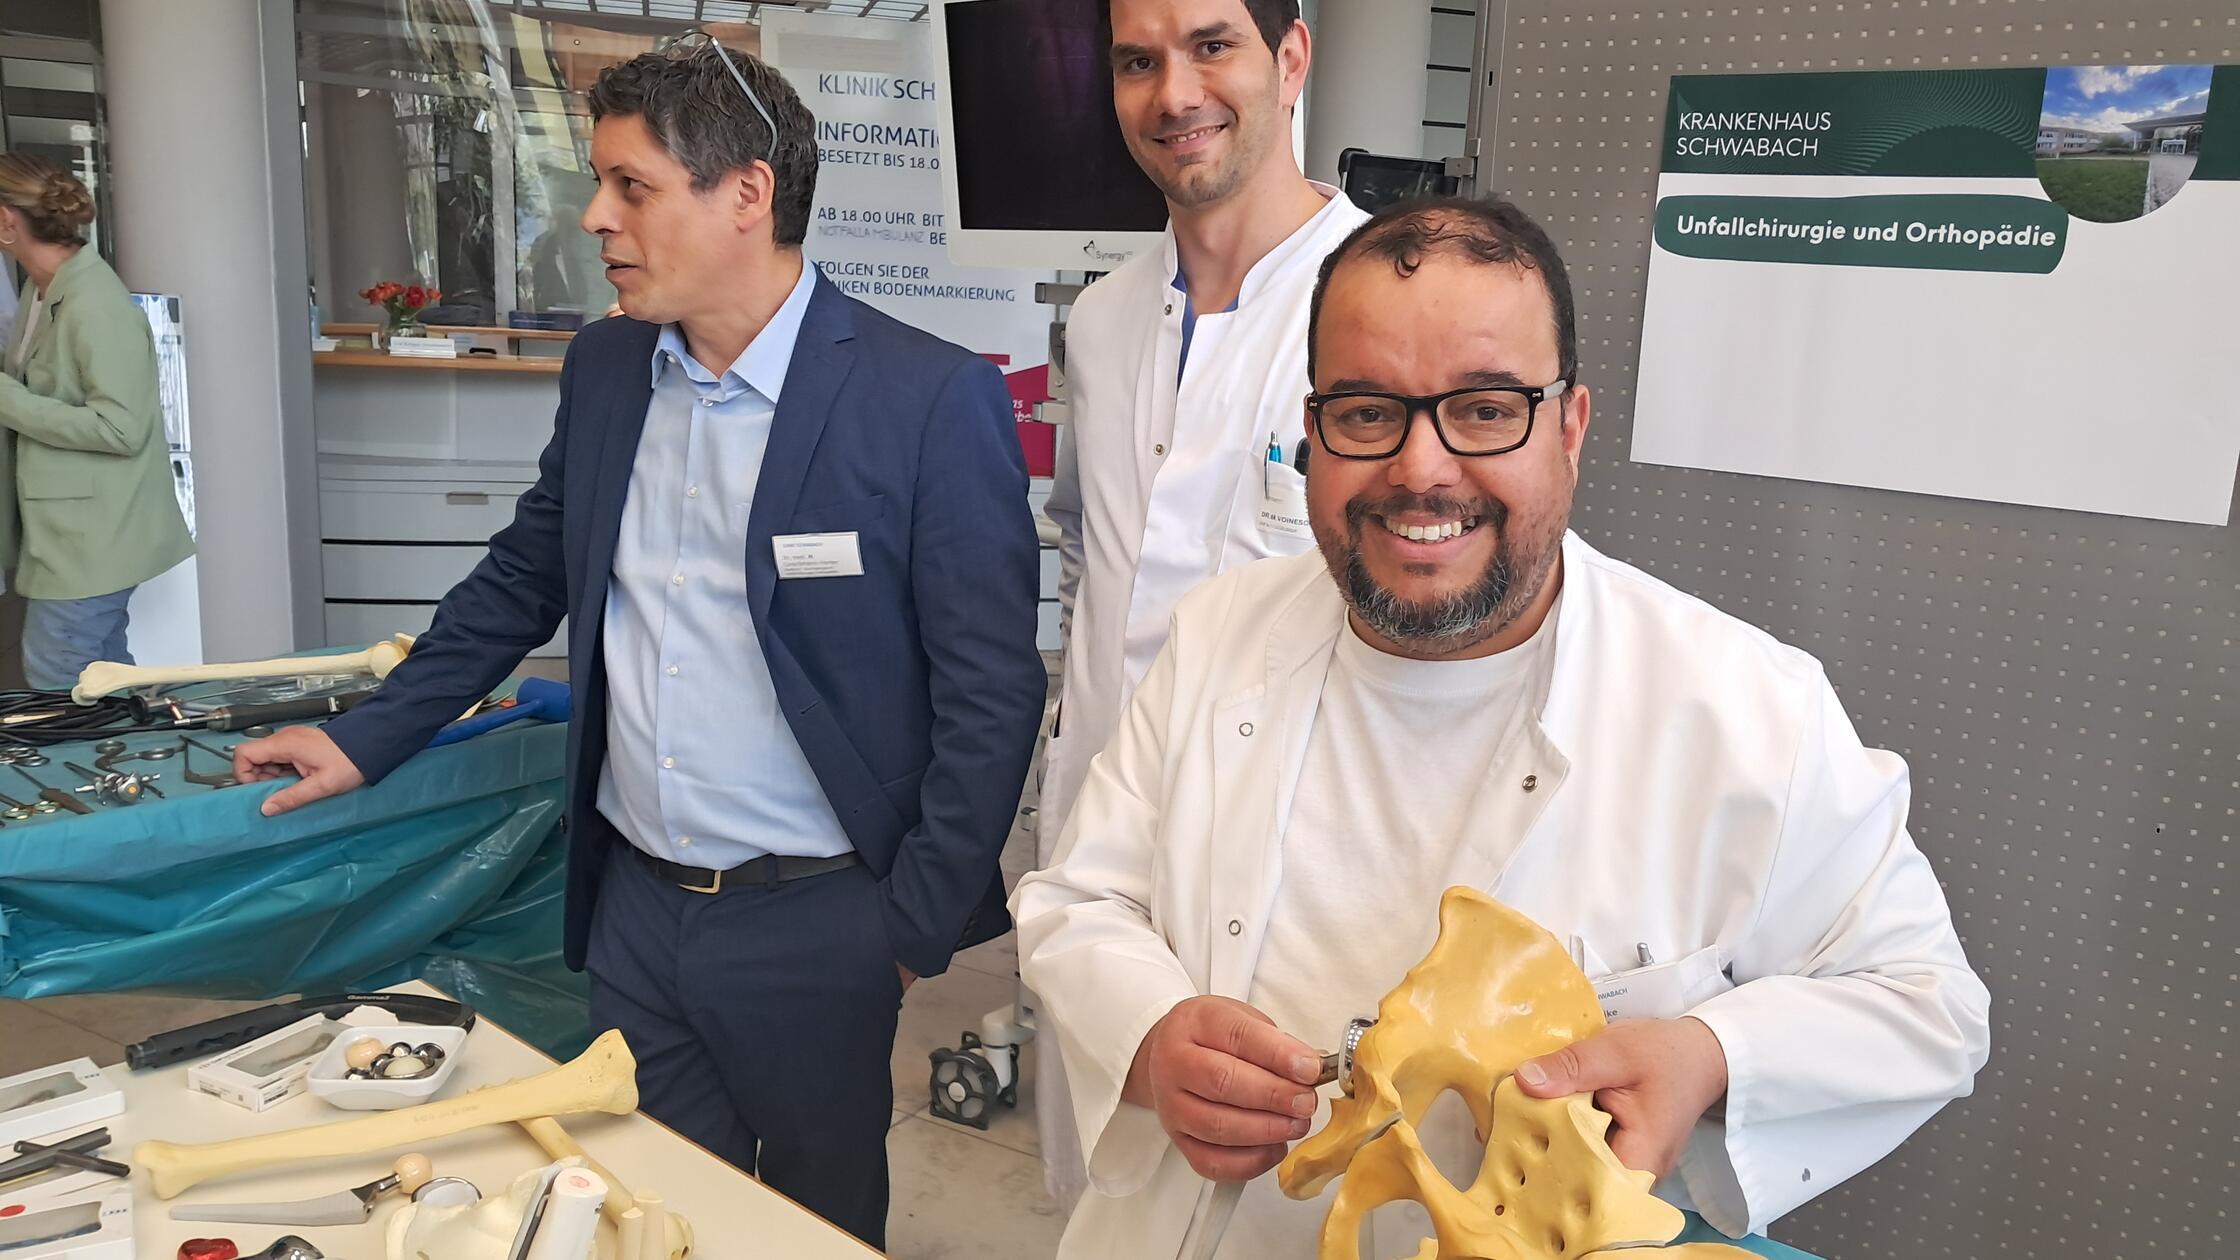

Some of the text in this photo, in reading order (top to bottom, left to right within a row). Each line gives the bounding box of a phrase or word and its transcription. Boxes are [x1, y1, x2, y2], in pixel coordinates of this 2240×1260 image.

[819, 73, 936, 101] KLINIK SCH
[1679, 111, 1832, 131] KRANKENHAUS
[818, 121, 940, 149] INFORMATI
[1676, 137, 1819, 157] SCHWABACH
[818, 149, 880, 165] BESETZT
[883, 153, 905, 168] BIS
[817, 207, 837, 221] AB
[841, 209, 882, 224] 18.00
[885, 211, 916, 226] UHR
[929, 231, 947, 246] BE
[1676, 214, 2057, 251] Unfallchirurgie und Orthopädie
[818, 260, 930, 280] FOLGEN SIE DER
[873, 281, 1016, 302] BODENMARKIERUNG
